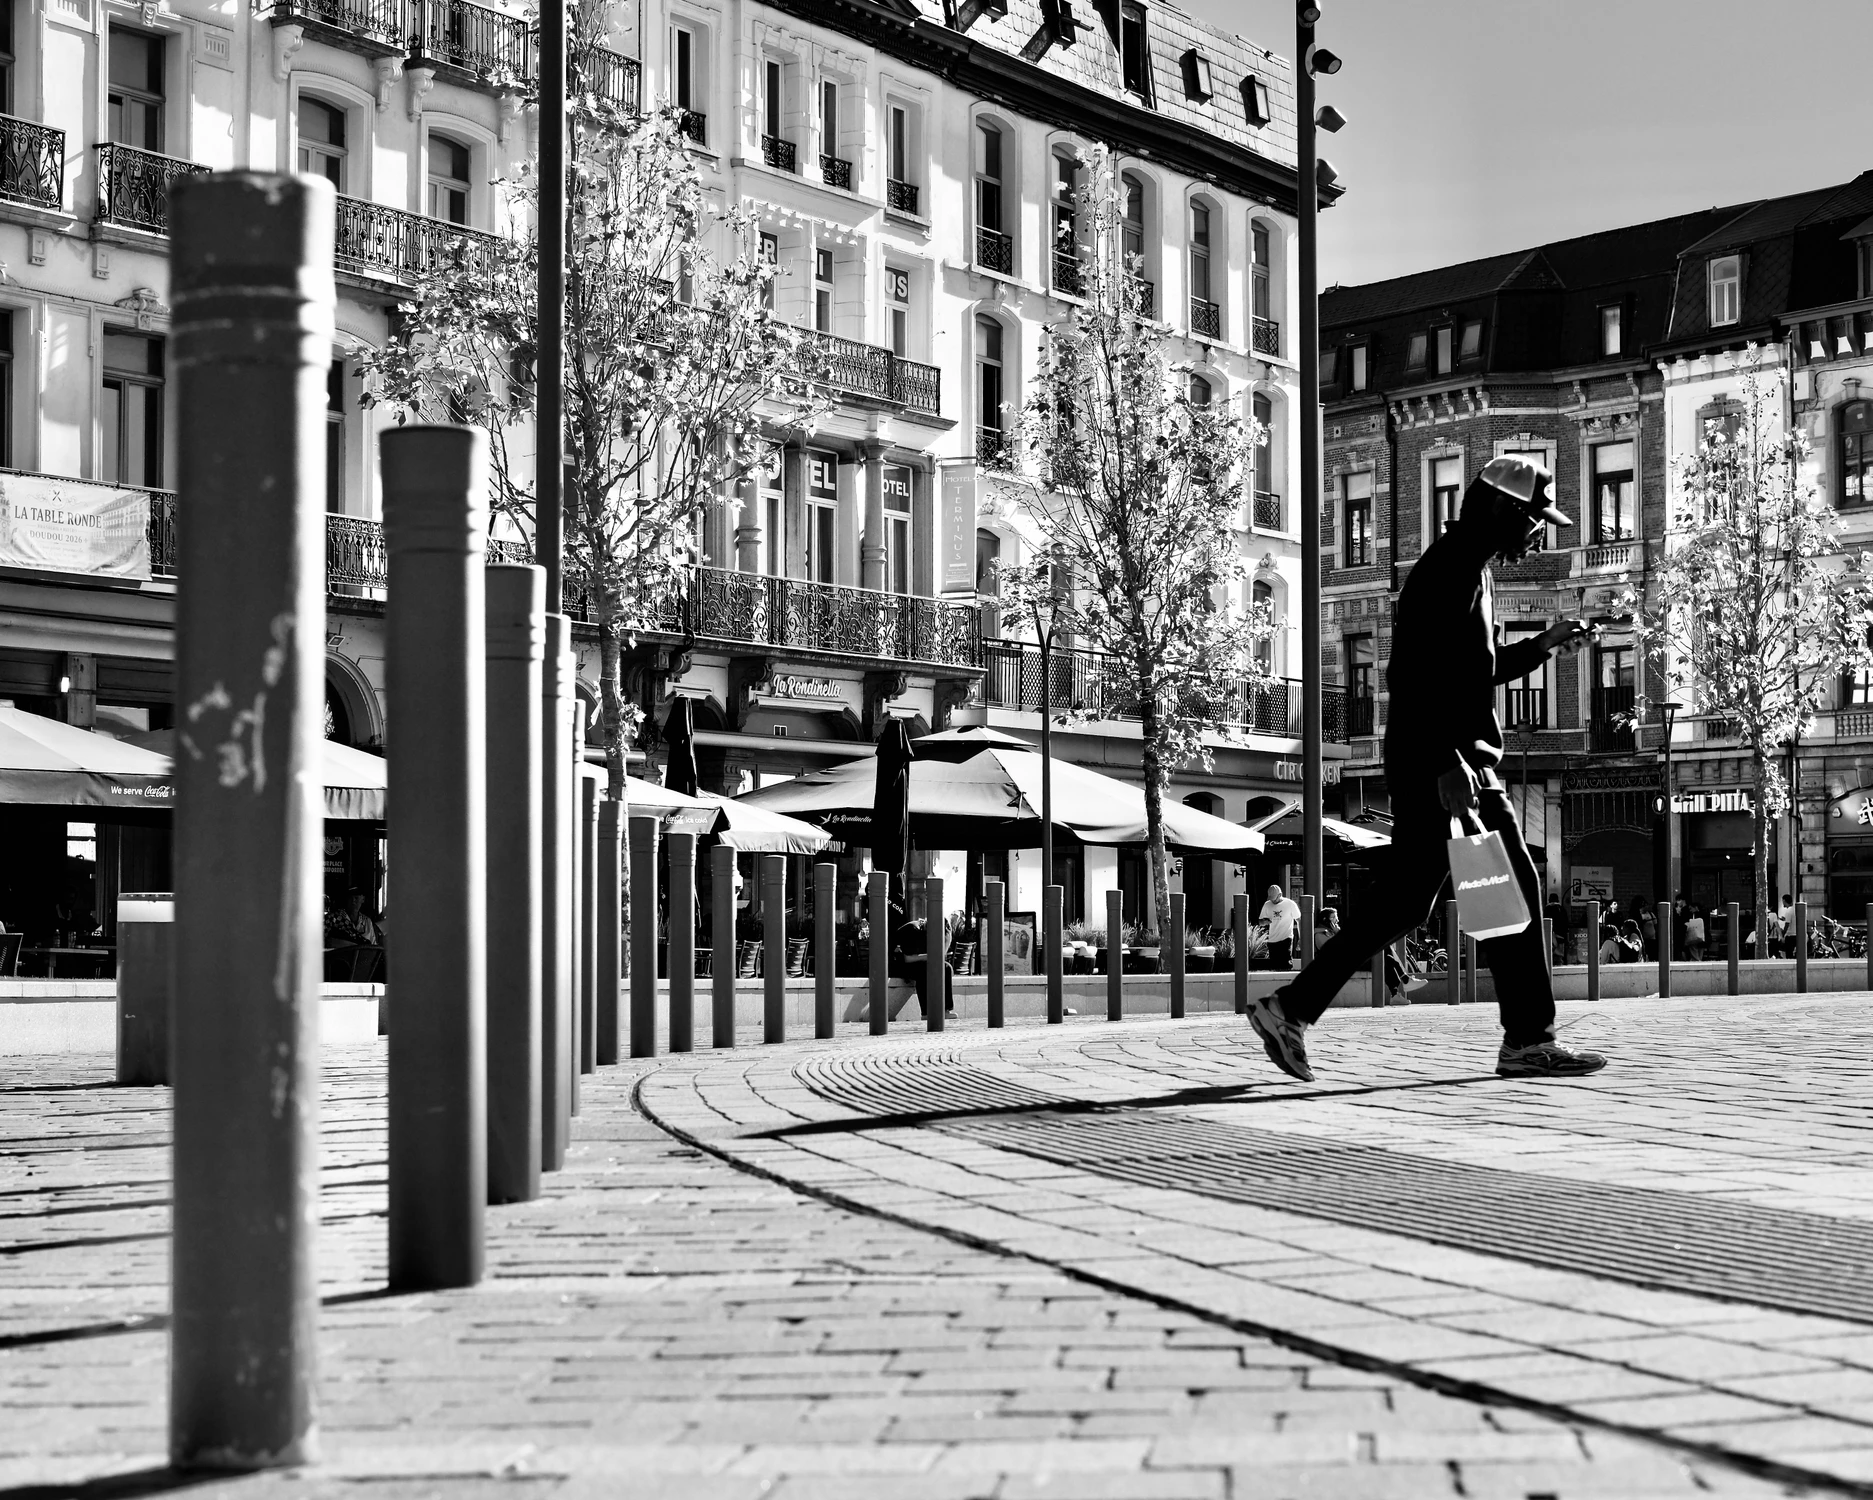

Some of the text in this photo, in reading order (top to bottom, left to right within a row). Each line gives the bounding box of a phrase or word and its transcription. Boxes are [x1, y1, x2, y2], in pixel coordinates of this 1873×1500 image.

[14, 505, 102, 529] LA TABLE RONDE
[953, 486, 964, 560] TERMINUS
[29, 530, 83, 544] DOUDOU 2026
[773, 674, 842, 698] La Rondinella
[1276, 760, 1341, 785] CTR CKEN
[110, 785, 122, 795] We
[123, 787, 143, 796] serve
[1711, 793, 1749, 812] PITTA
